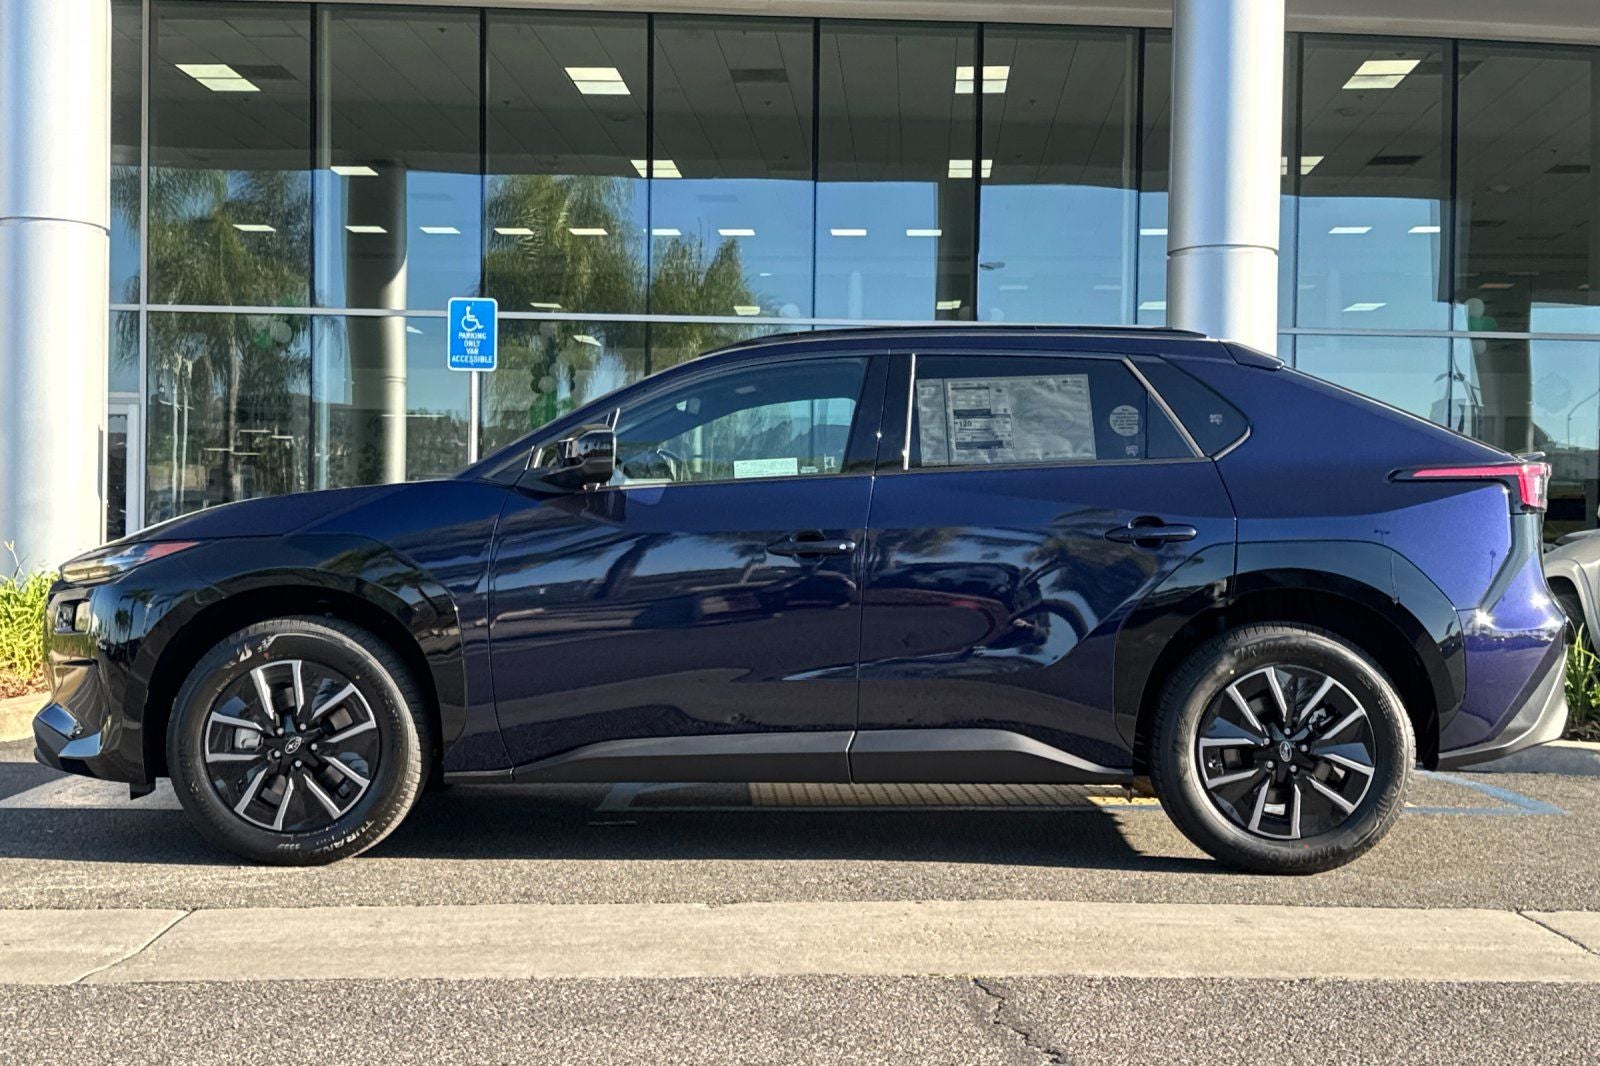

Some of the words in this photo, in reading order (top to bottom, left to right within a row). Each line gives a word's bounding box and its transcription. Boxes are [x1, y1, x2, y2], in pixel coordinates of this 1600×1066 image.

[458, 332, 487, 340] PARKING
[463, 340, 481, 348] ONLY
[451, 355, 493, 364] ACCESSIBLE
